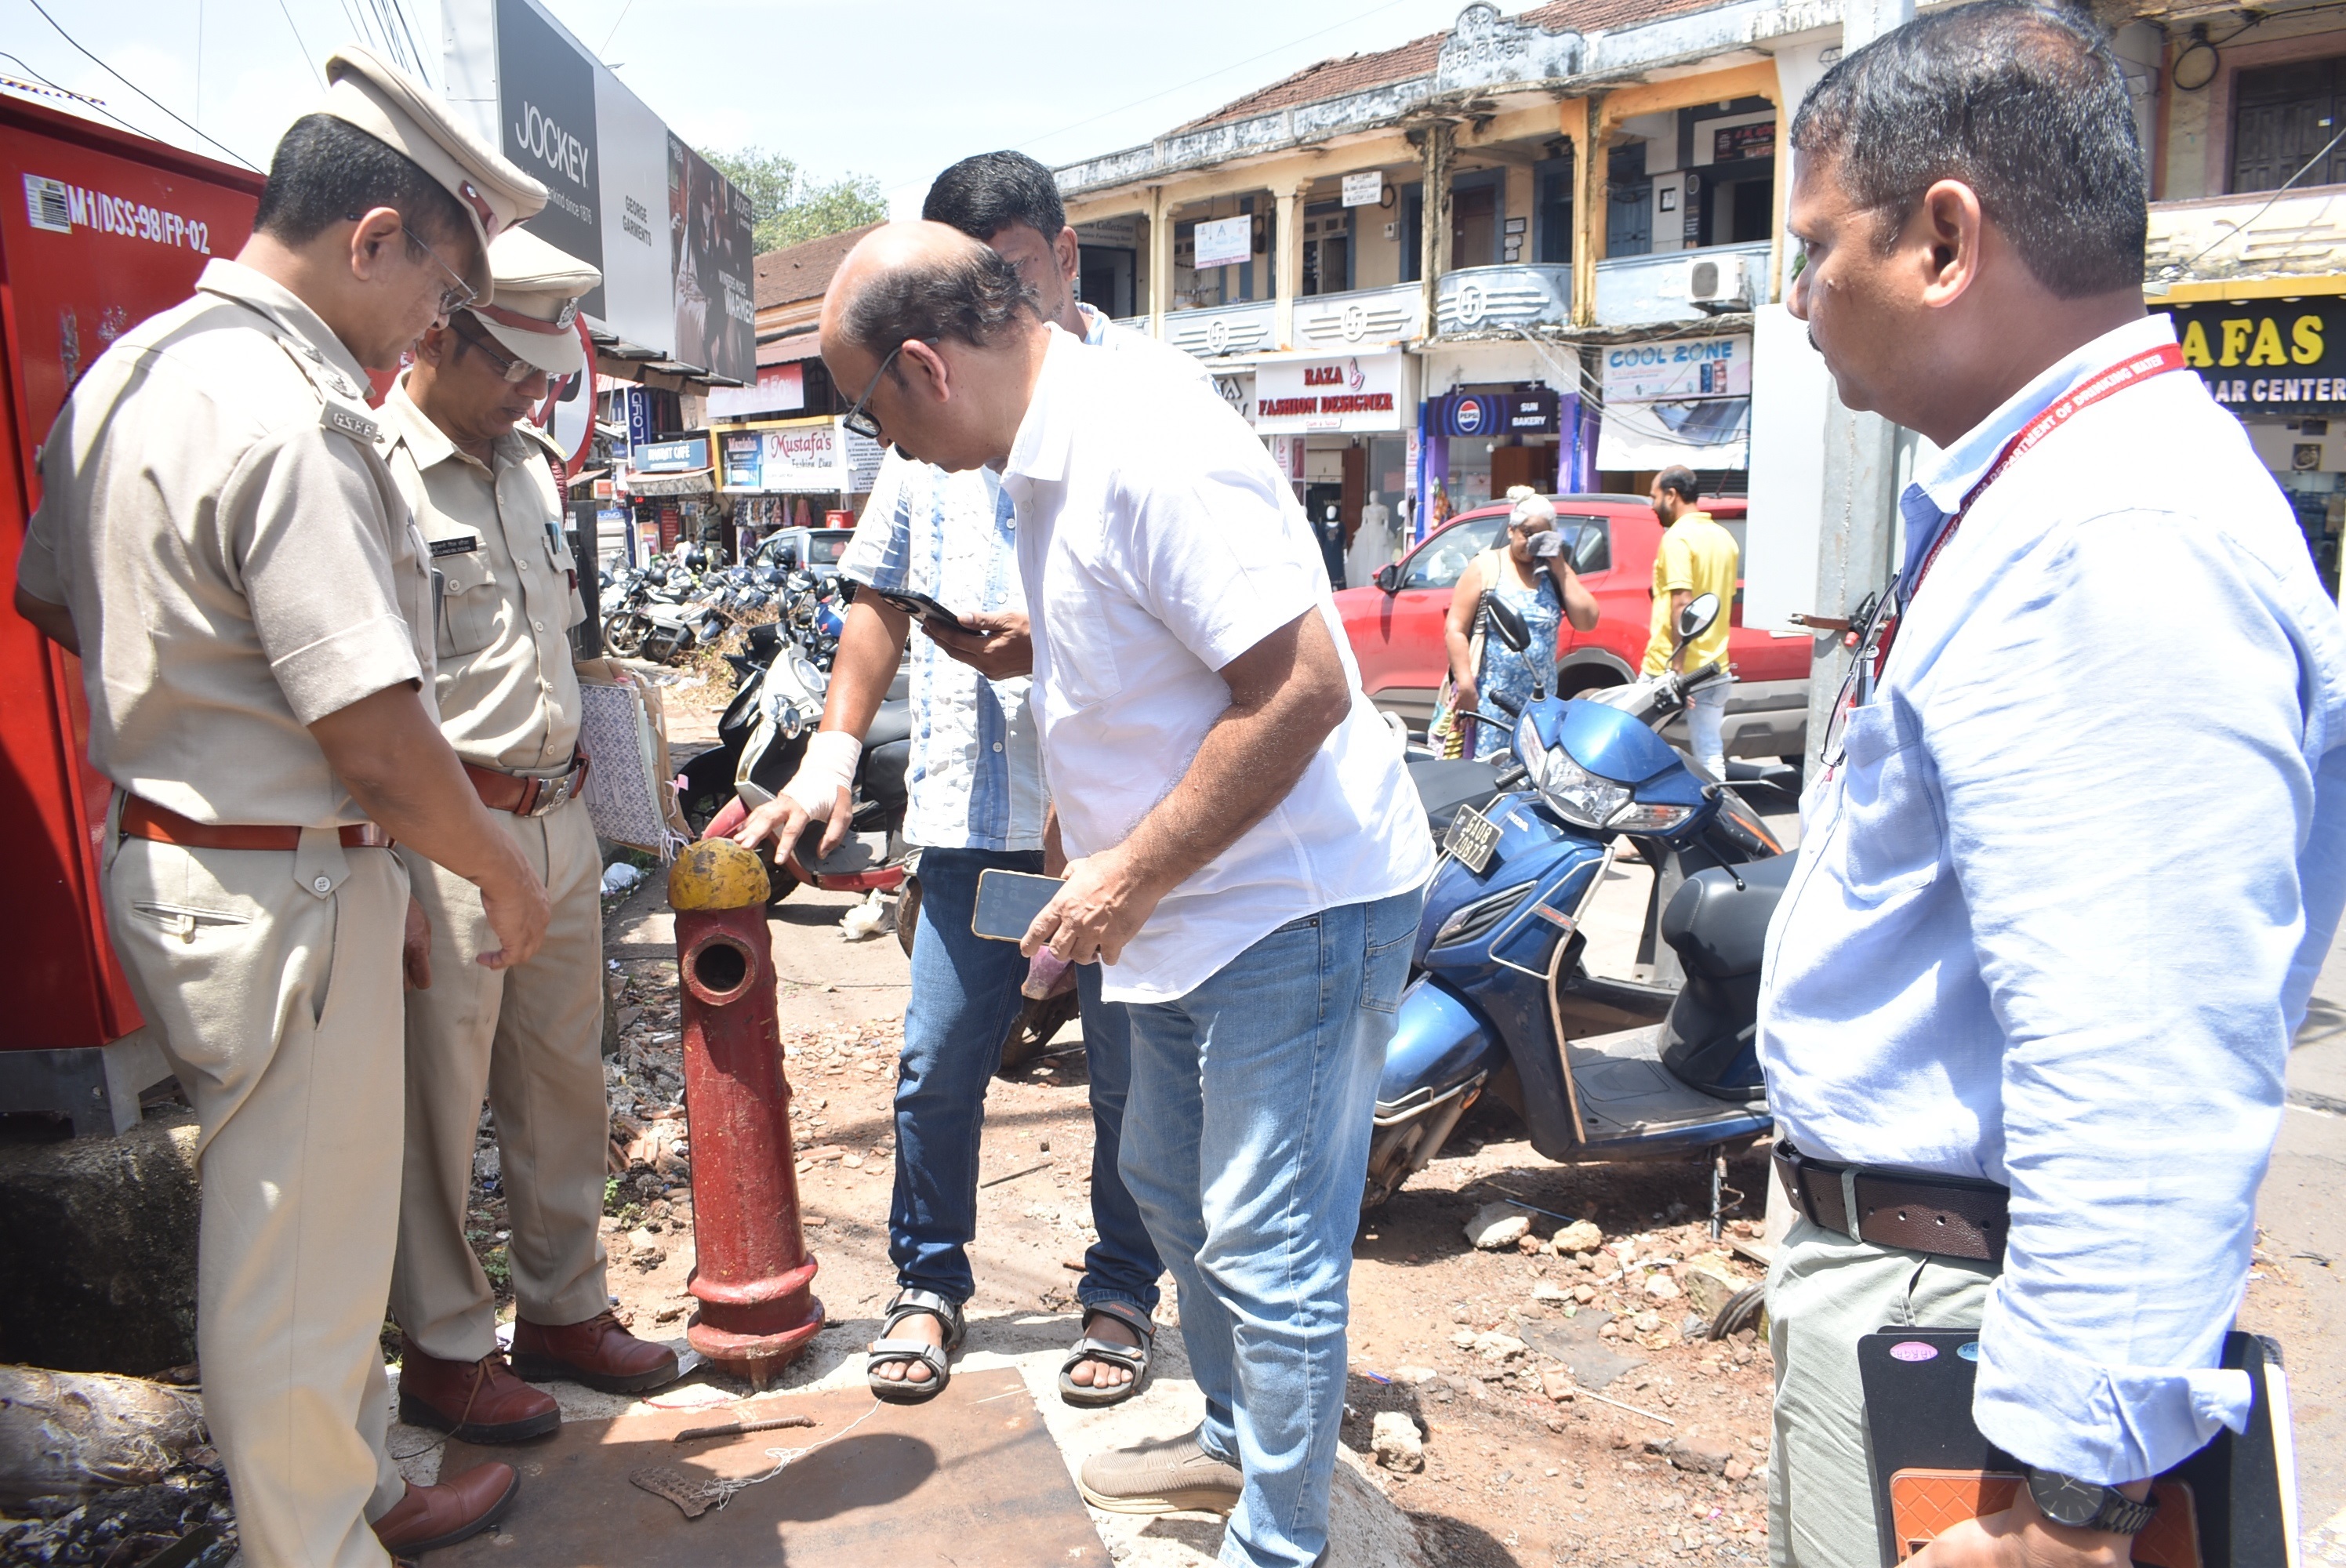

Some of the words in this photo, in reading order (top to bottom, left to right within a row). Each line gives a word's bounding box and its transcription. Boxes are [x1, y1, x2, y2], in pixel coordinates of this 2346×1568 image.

[515, 100, 588, 188] JOCKEY
[566, 196, 579, 217] since
[625, 194, 648, 224] GEORGE
[622, 214, 652, 247] GARMENTS
[1096, 220, 1134, 233] Collections
[723, 287, 755, 325] WARMER
[1610, 347, 1667, 368] COOL
[1673, 340, 1734, 363] ZONE
[1304, 365, 1345, 386] RAZA
[2205, 379, 2248, 402] AR
[2251, 378, 2346, 402] CENTER
[1258, 396, 1318, 416] FASHION
[1320, 393, 1394, 414] DESIGNER
[1520, 402, 1538, 412] SUN
[632, 392, 645, 446] LOYD
[1512, 416, 1546, 426] BAKERY
[771, 432, 832, 460] Mustafa's
[1970, 481, 1989, 504] GOA
[1988, 415, 2057, 482] DEPARTMENT
[2055, 401, 2072, 419] OF
[2071, 367, 2134, 407] DRINKING
[1465, 815, 1493, 844] GA08
[1109, 1303, 1136, 1317] power
